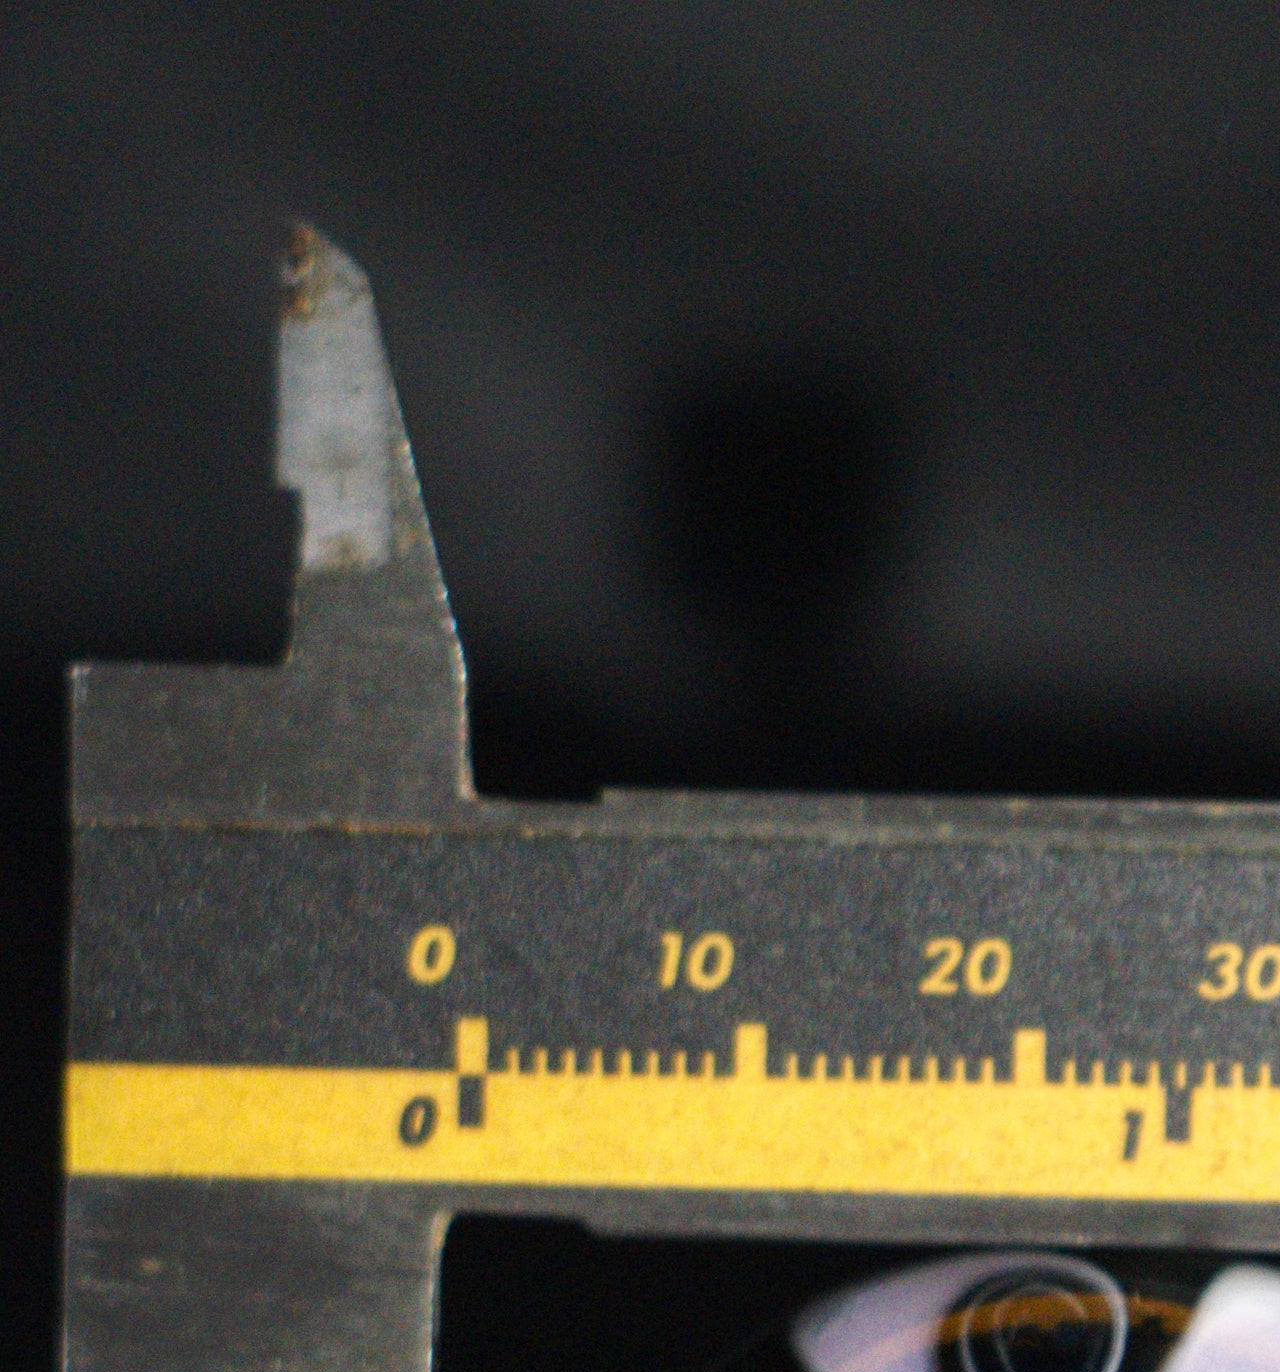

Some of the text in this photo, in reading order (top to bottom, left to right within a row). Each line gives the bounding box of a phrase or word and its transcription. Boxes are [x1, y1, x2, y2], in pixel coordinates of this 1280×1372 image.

[409, 924, 456, 986] 0
[659, 931, 735, 991] 10
[920, 937, 1012, 996] 20
[399, 1097, 1144, 1161] 0 1
